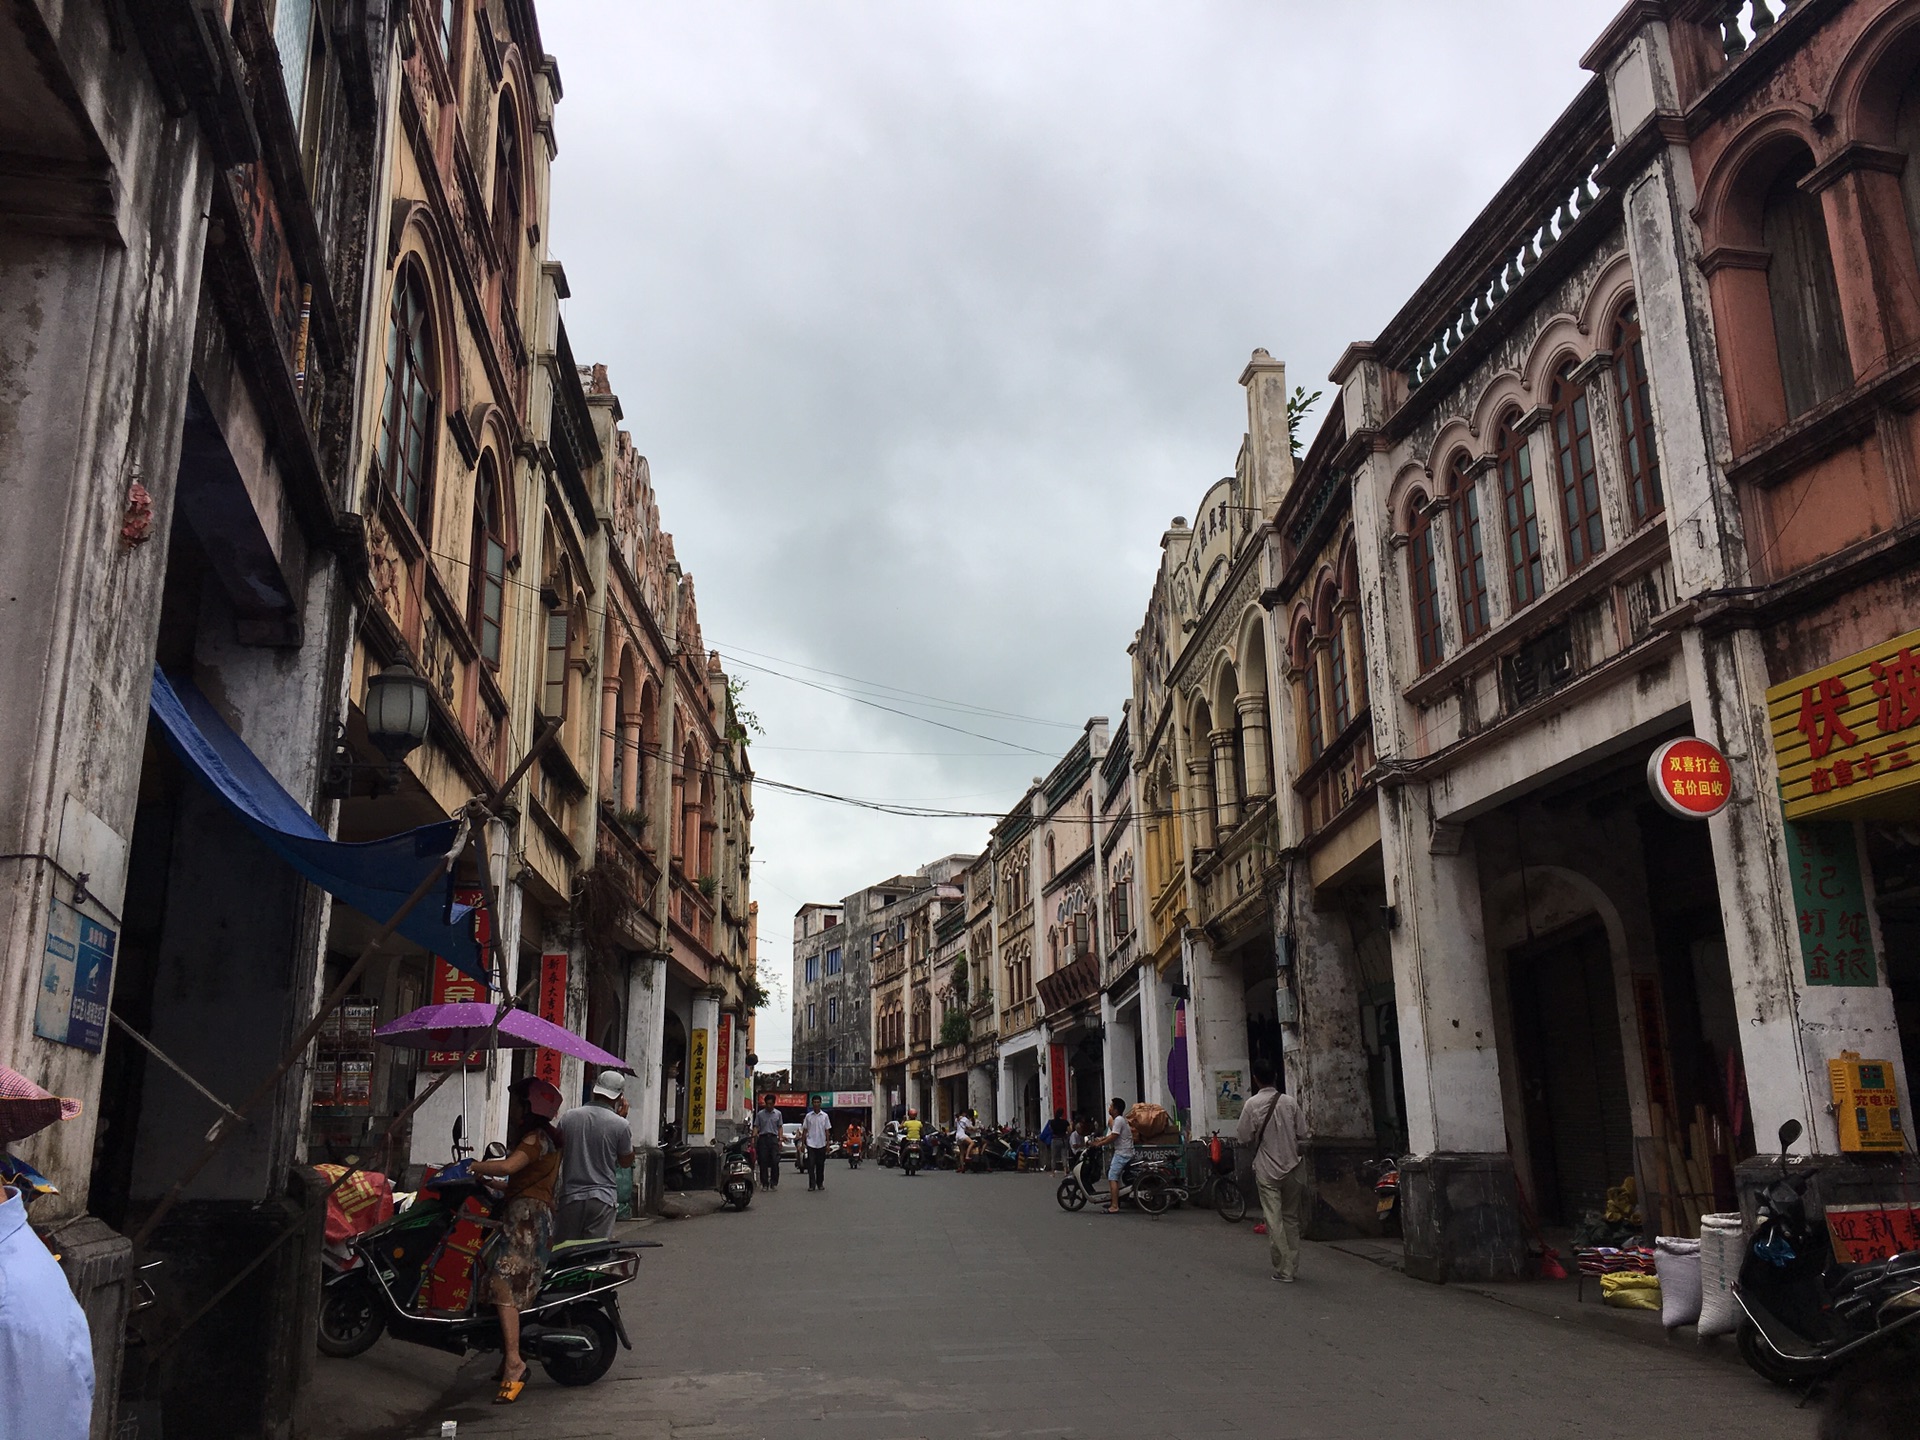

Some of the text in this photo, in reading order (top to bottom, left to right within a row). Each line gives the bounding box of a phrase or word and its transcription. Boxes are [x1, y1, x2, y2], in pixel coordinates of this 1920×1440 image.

[1669, 756, 1721, 773] 双喜打金
[1810, 741, 1913, 794] 出售十三
[1672, 779, 1724, 796] 高价回收
[1855, 1095, 1897, 1107] 充电站
